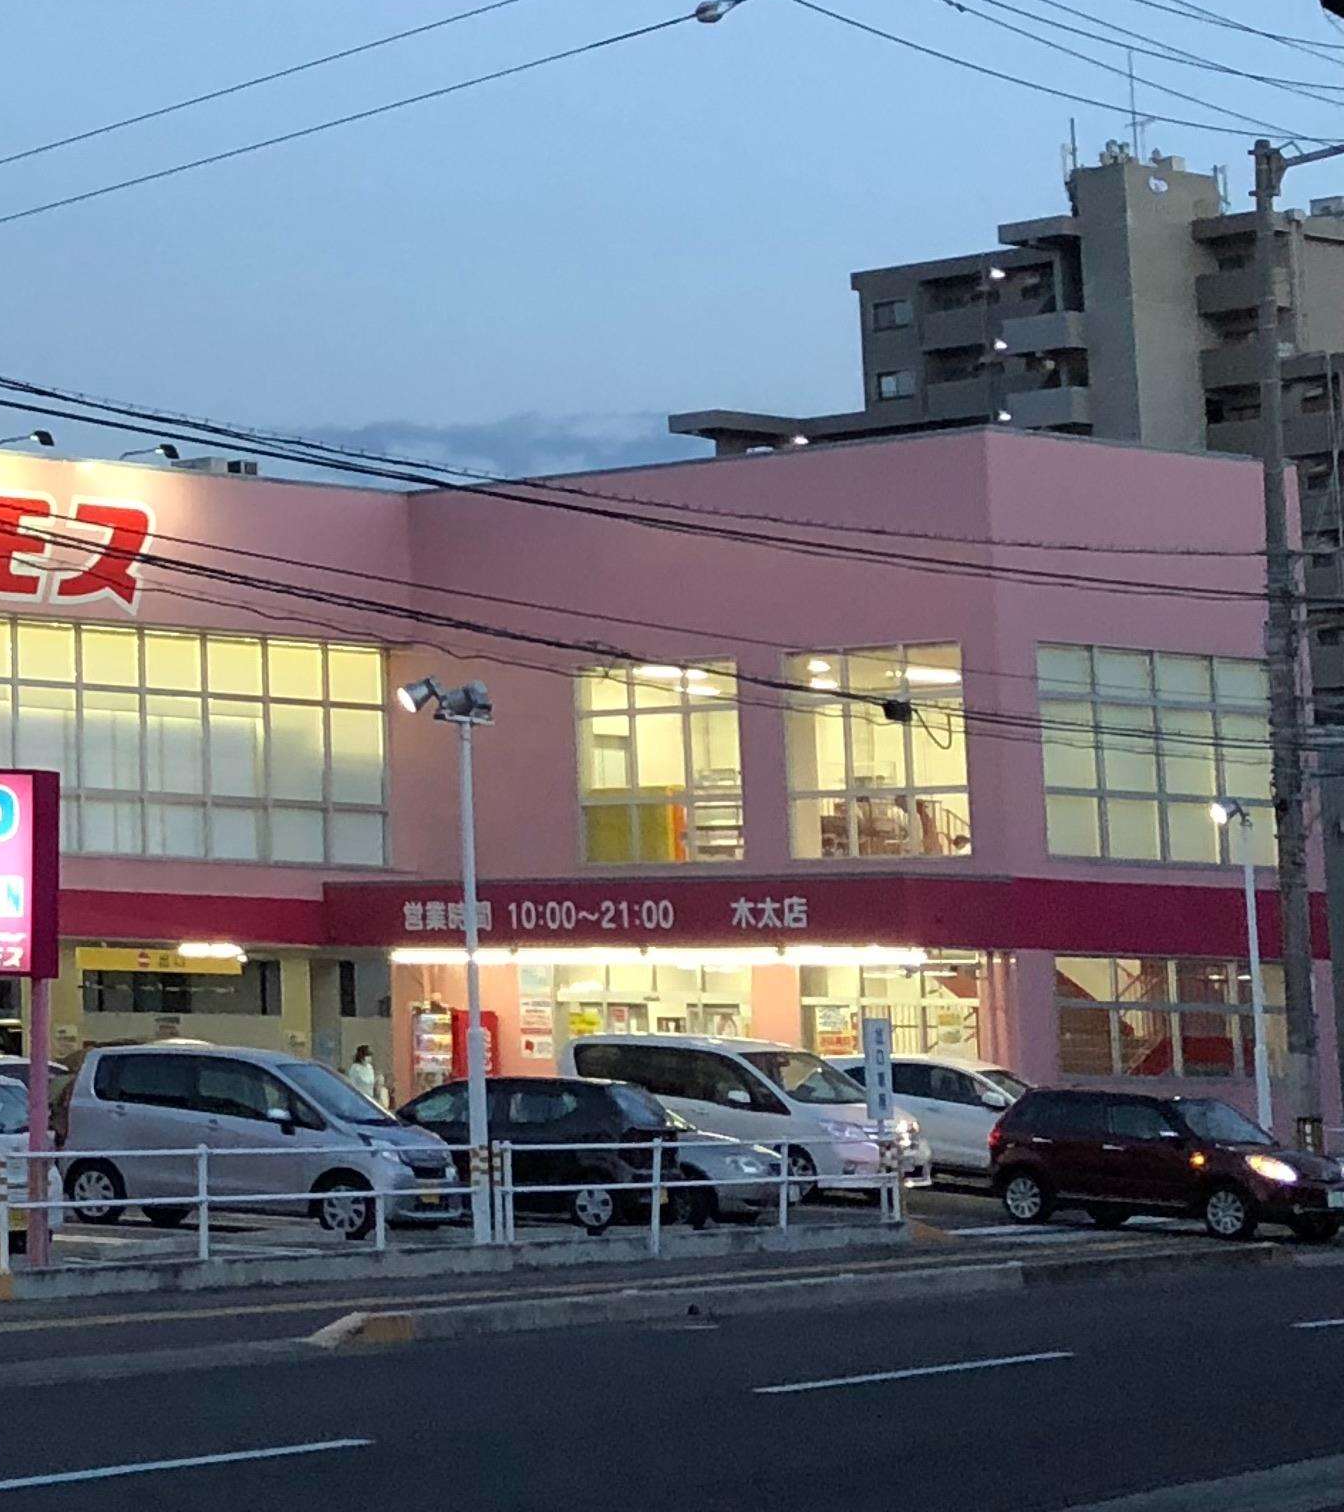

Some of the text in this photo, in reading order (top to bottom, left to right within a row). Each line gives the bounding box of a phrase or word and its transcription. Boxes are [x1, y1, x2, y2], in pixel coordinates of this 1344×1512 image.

[403, 900, 493, 931] 営業時間
[729, 896, 809, 929] 木太店
